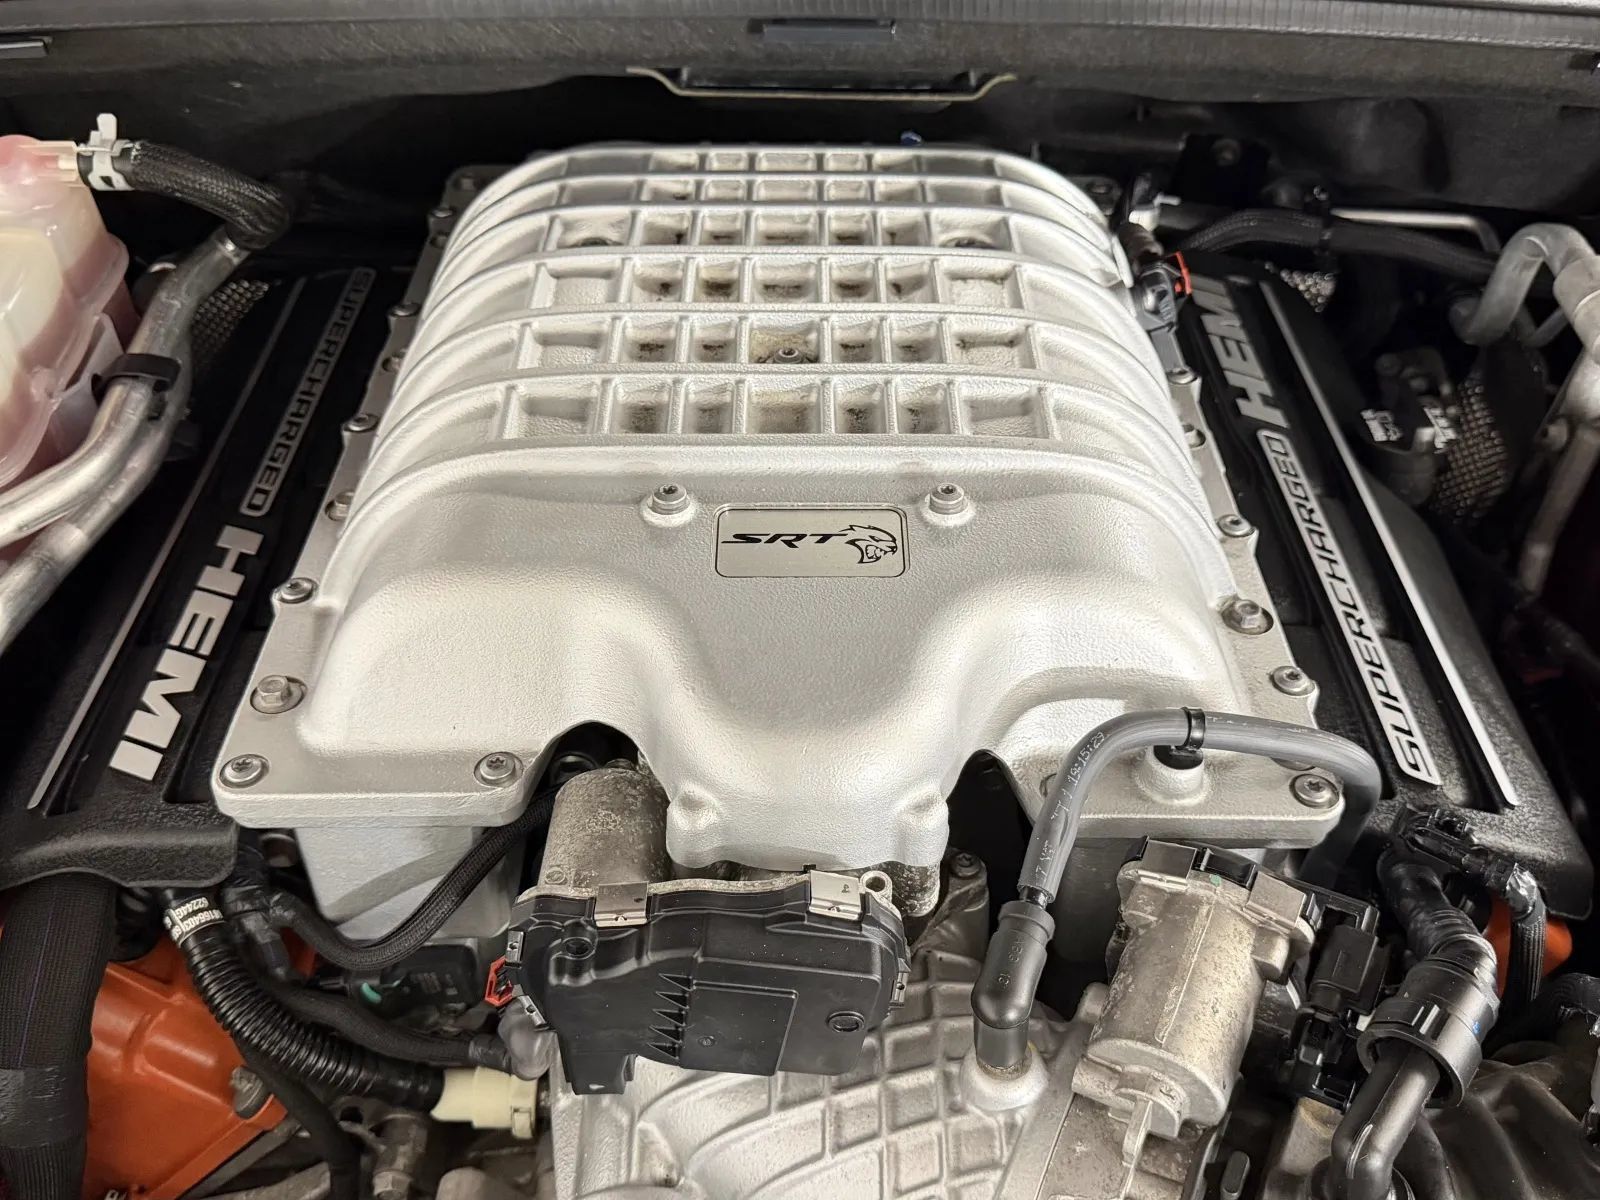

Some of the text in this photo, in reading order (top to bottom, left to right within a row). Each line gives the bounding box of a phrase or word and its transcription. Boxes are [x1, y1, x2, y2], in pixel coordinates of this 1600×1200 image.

[1189, 274, 1291, 429] HEMI
[109, 267, 375, 781] SUPERCHARGED HEMI
[721, 533, 848, 548] SRT
[1261, 432, 1437, 781] SUPERCHARGED
